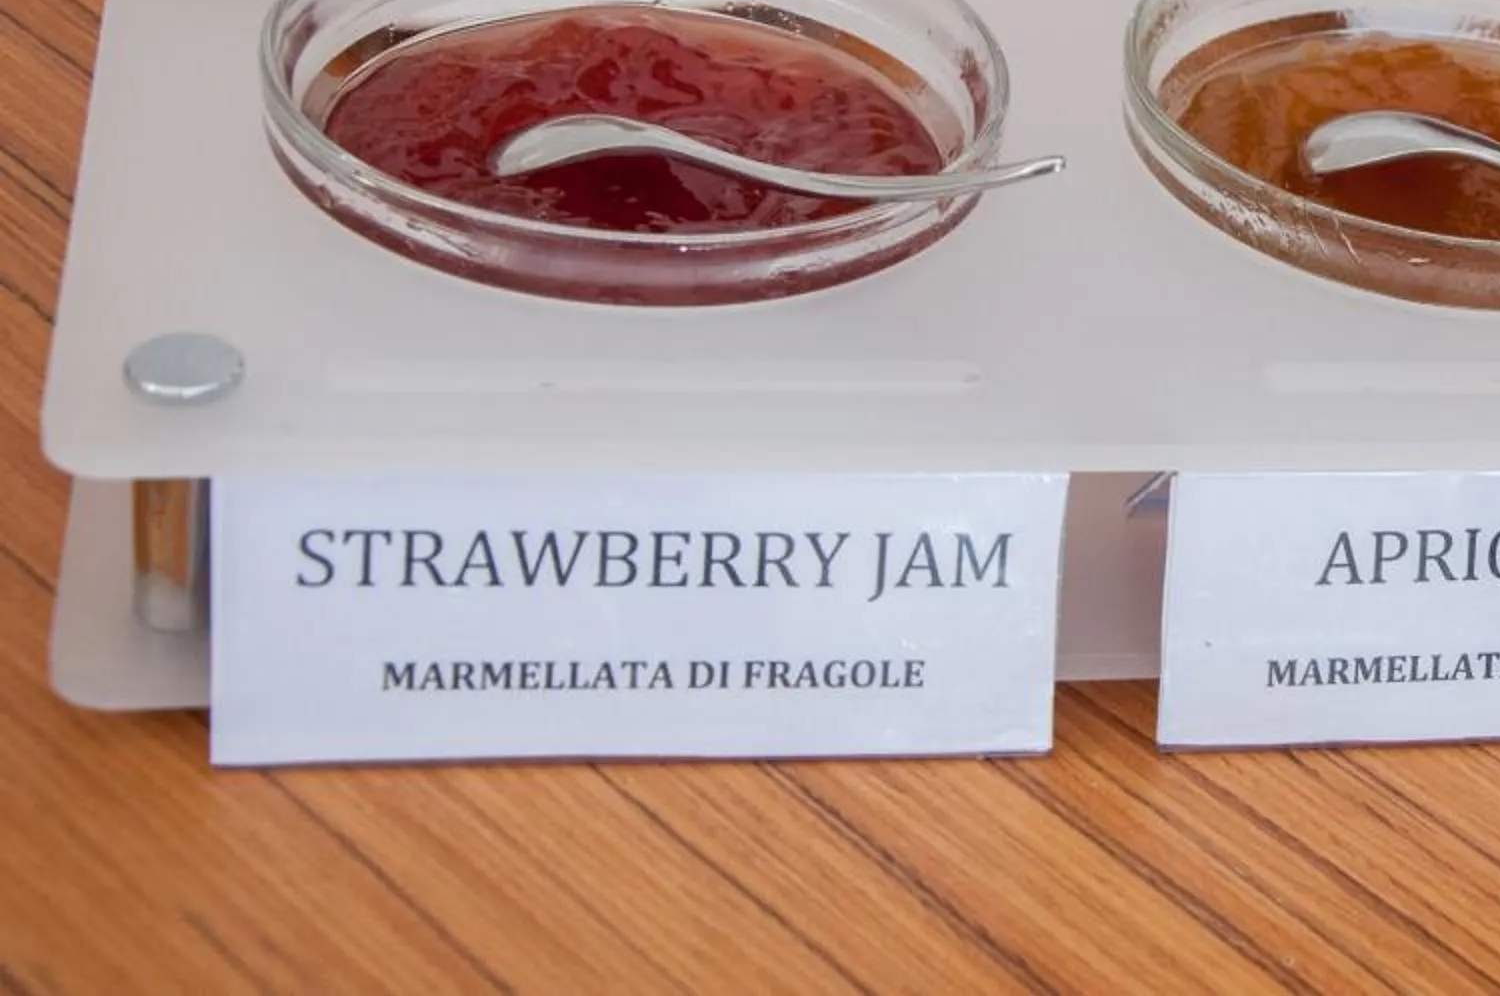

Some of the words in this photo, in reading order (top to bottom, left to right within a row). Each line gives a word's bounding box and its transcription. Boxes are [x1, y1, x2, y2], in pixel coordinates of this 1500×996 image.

[296, 528, 851, 588] STRAWBERRY
[867, 531, 1013, 603] JAM
[382, 660, 674, 691] MARMELLATA
[687, 660, 730, 689] DI
[743, 659, 926, 689] FRAGOLE
